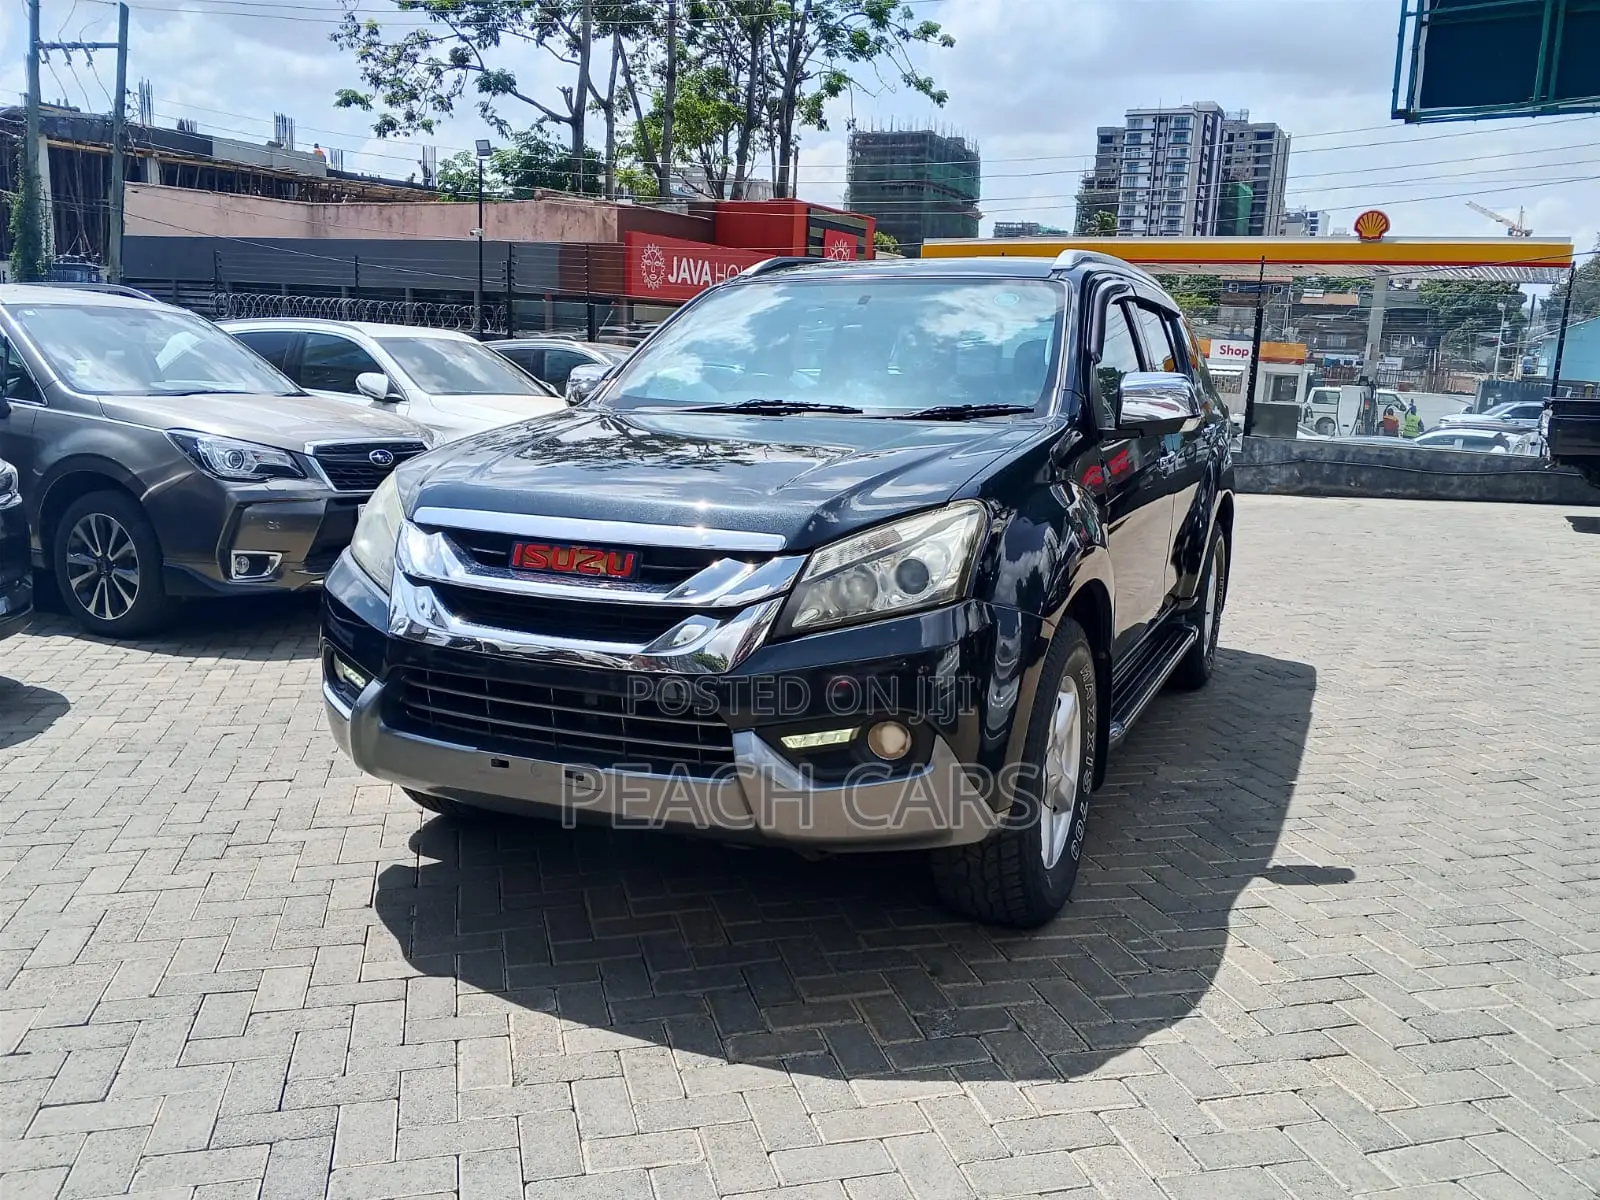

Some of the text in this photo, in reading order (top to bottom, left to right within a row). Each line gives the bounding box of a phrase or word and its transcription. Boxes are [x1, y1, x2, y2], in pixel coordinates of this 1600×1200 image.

[668, 256, 712, 286] JAVA
[1219, 345, 1249, 358] Shop
[512, 543, 634, 577] ISUZU
[1080, 664, 1095, 794] MAXXIS
